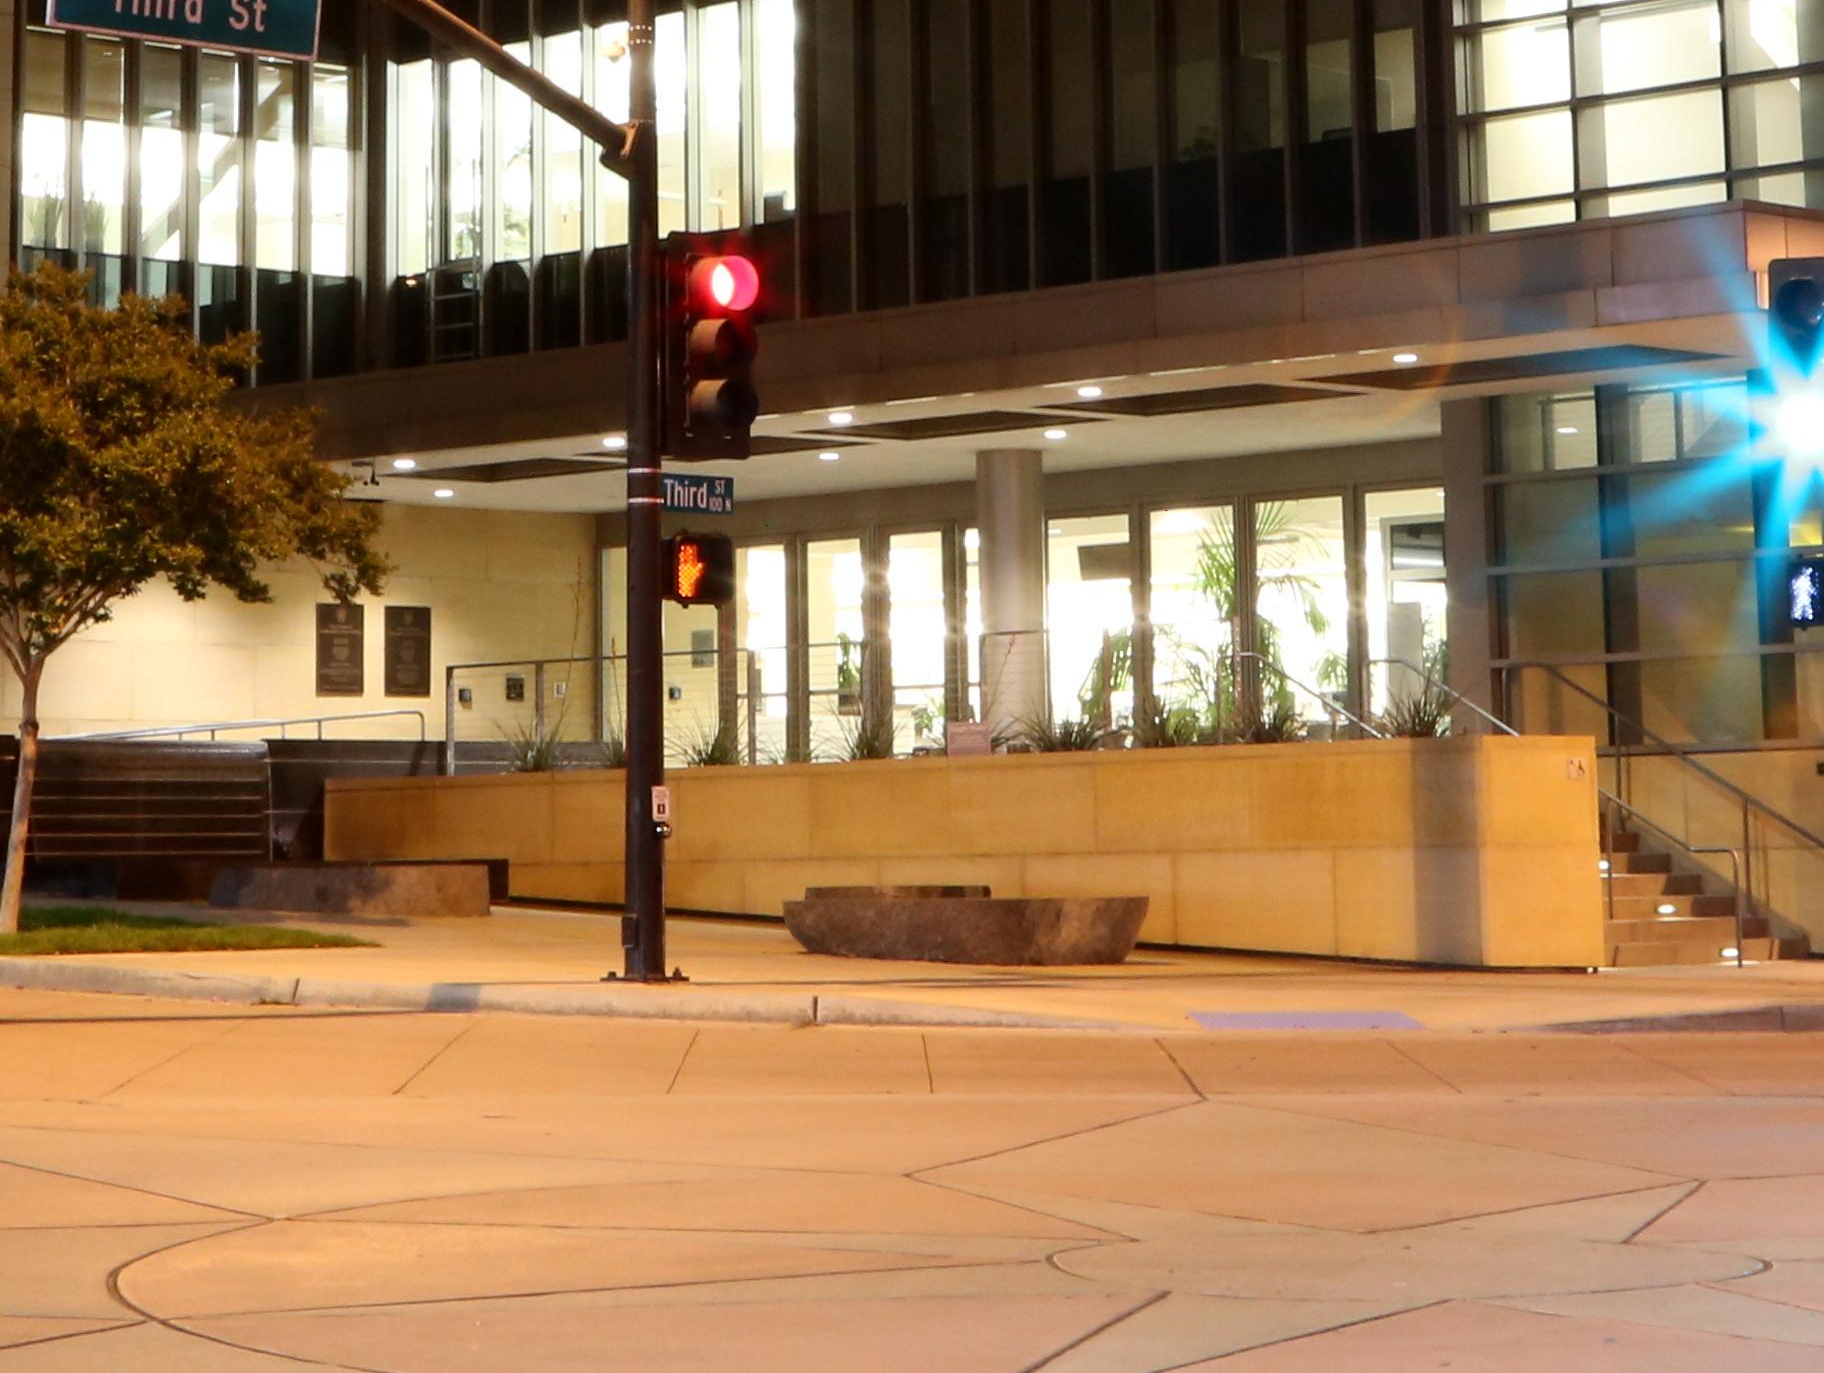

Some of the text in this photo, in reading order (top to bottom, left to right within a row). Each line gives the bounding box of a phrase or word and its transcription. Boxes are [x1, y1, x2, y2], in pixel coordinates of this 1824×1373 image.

[663, 477, 708, 509] Third
[714, 479, 726, 495] ST
[709, 496, 732, 513] 100 N
